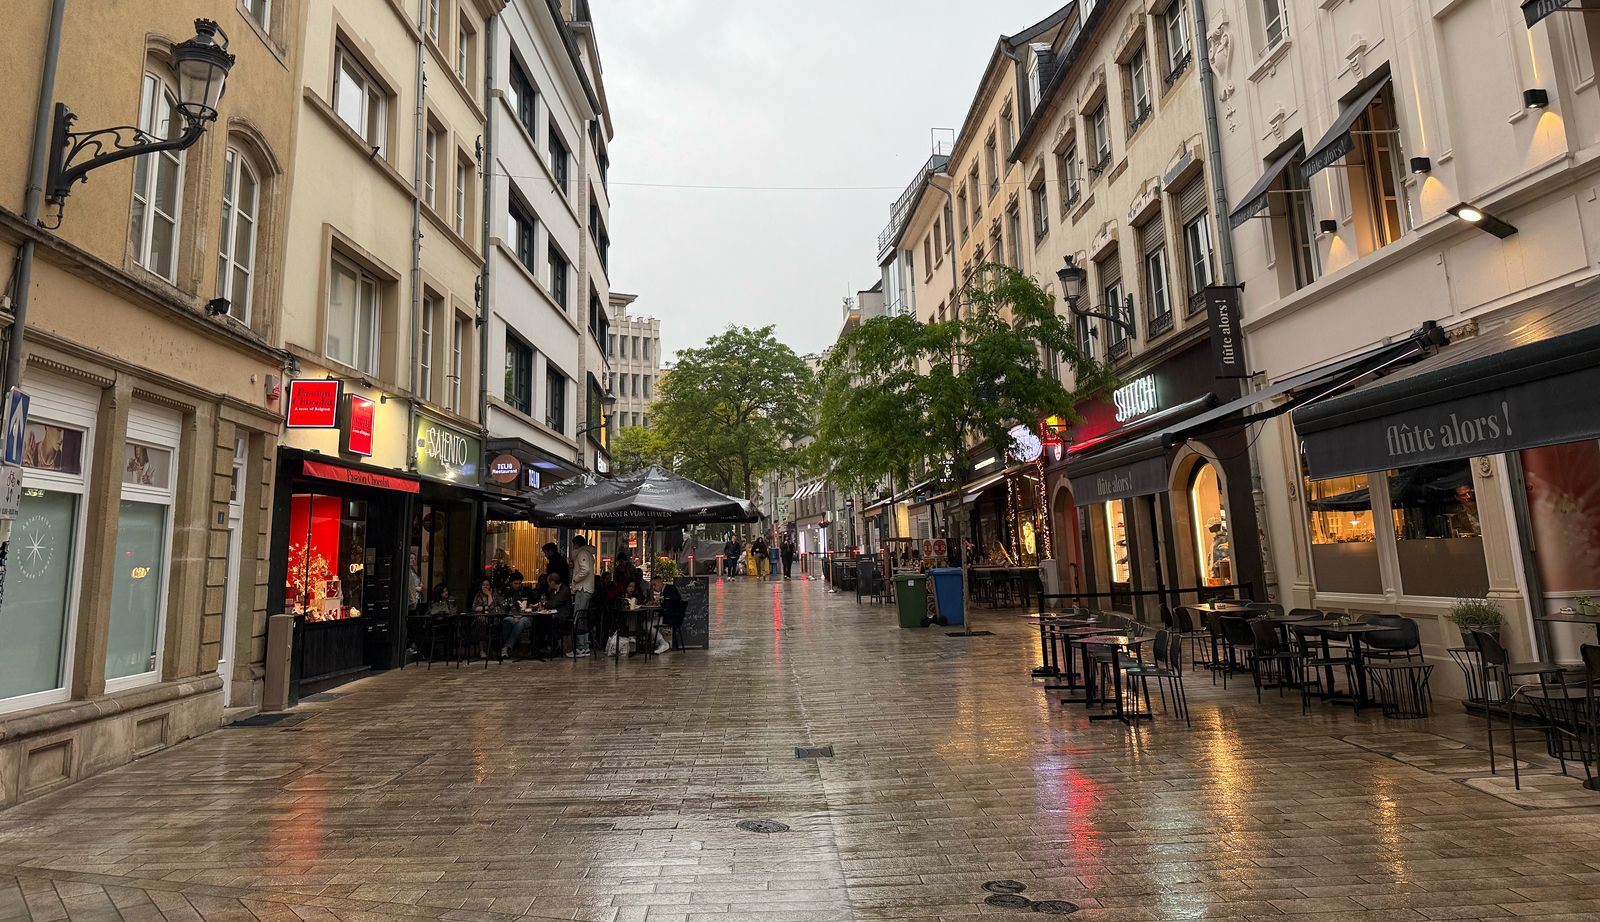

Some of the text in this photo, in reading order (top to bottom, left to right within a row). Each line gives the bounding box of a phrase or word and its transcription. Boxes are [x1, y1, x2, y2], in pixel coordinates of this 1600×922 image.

[1222, 337, 1235, 365] flûte
[292, 397, 334, 406] Chocolat
[297, 388, 331, 397] Passion
[1386, 401, 1513, 457] flûte alors!
[427, 427, 468, 466] SALENTO
[347, 469, 390, 488] Passion Chocolat
